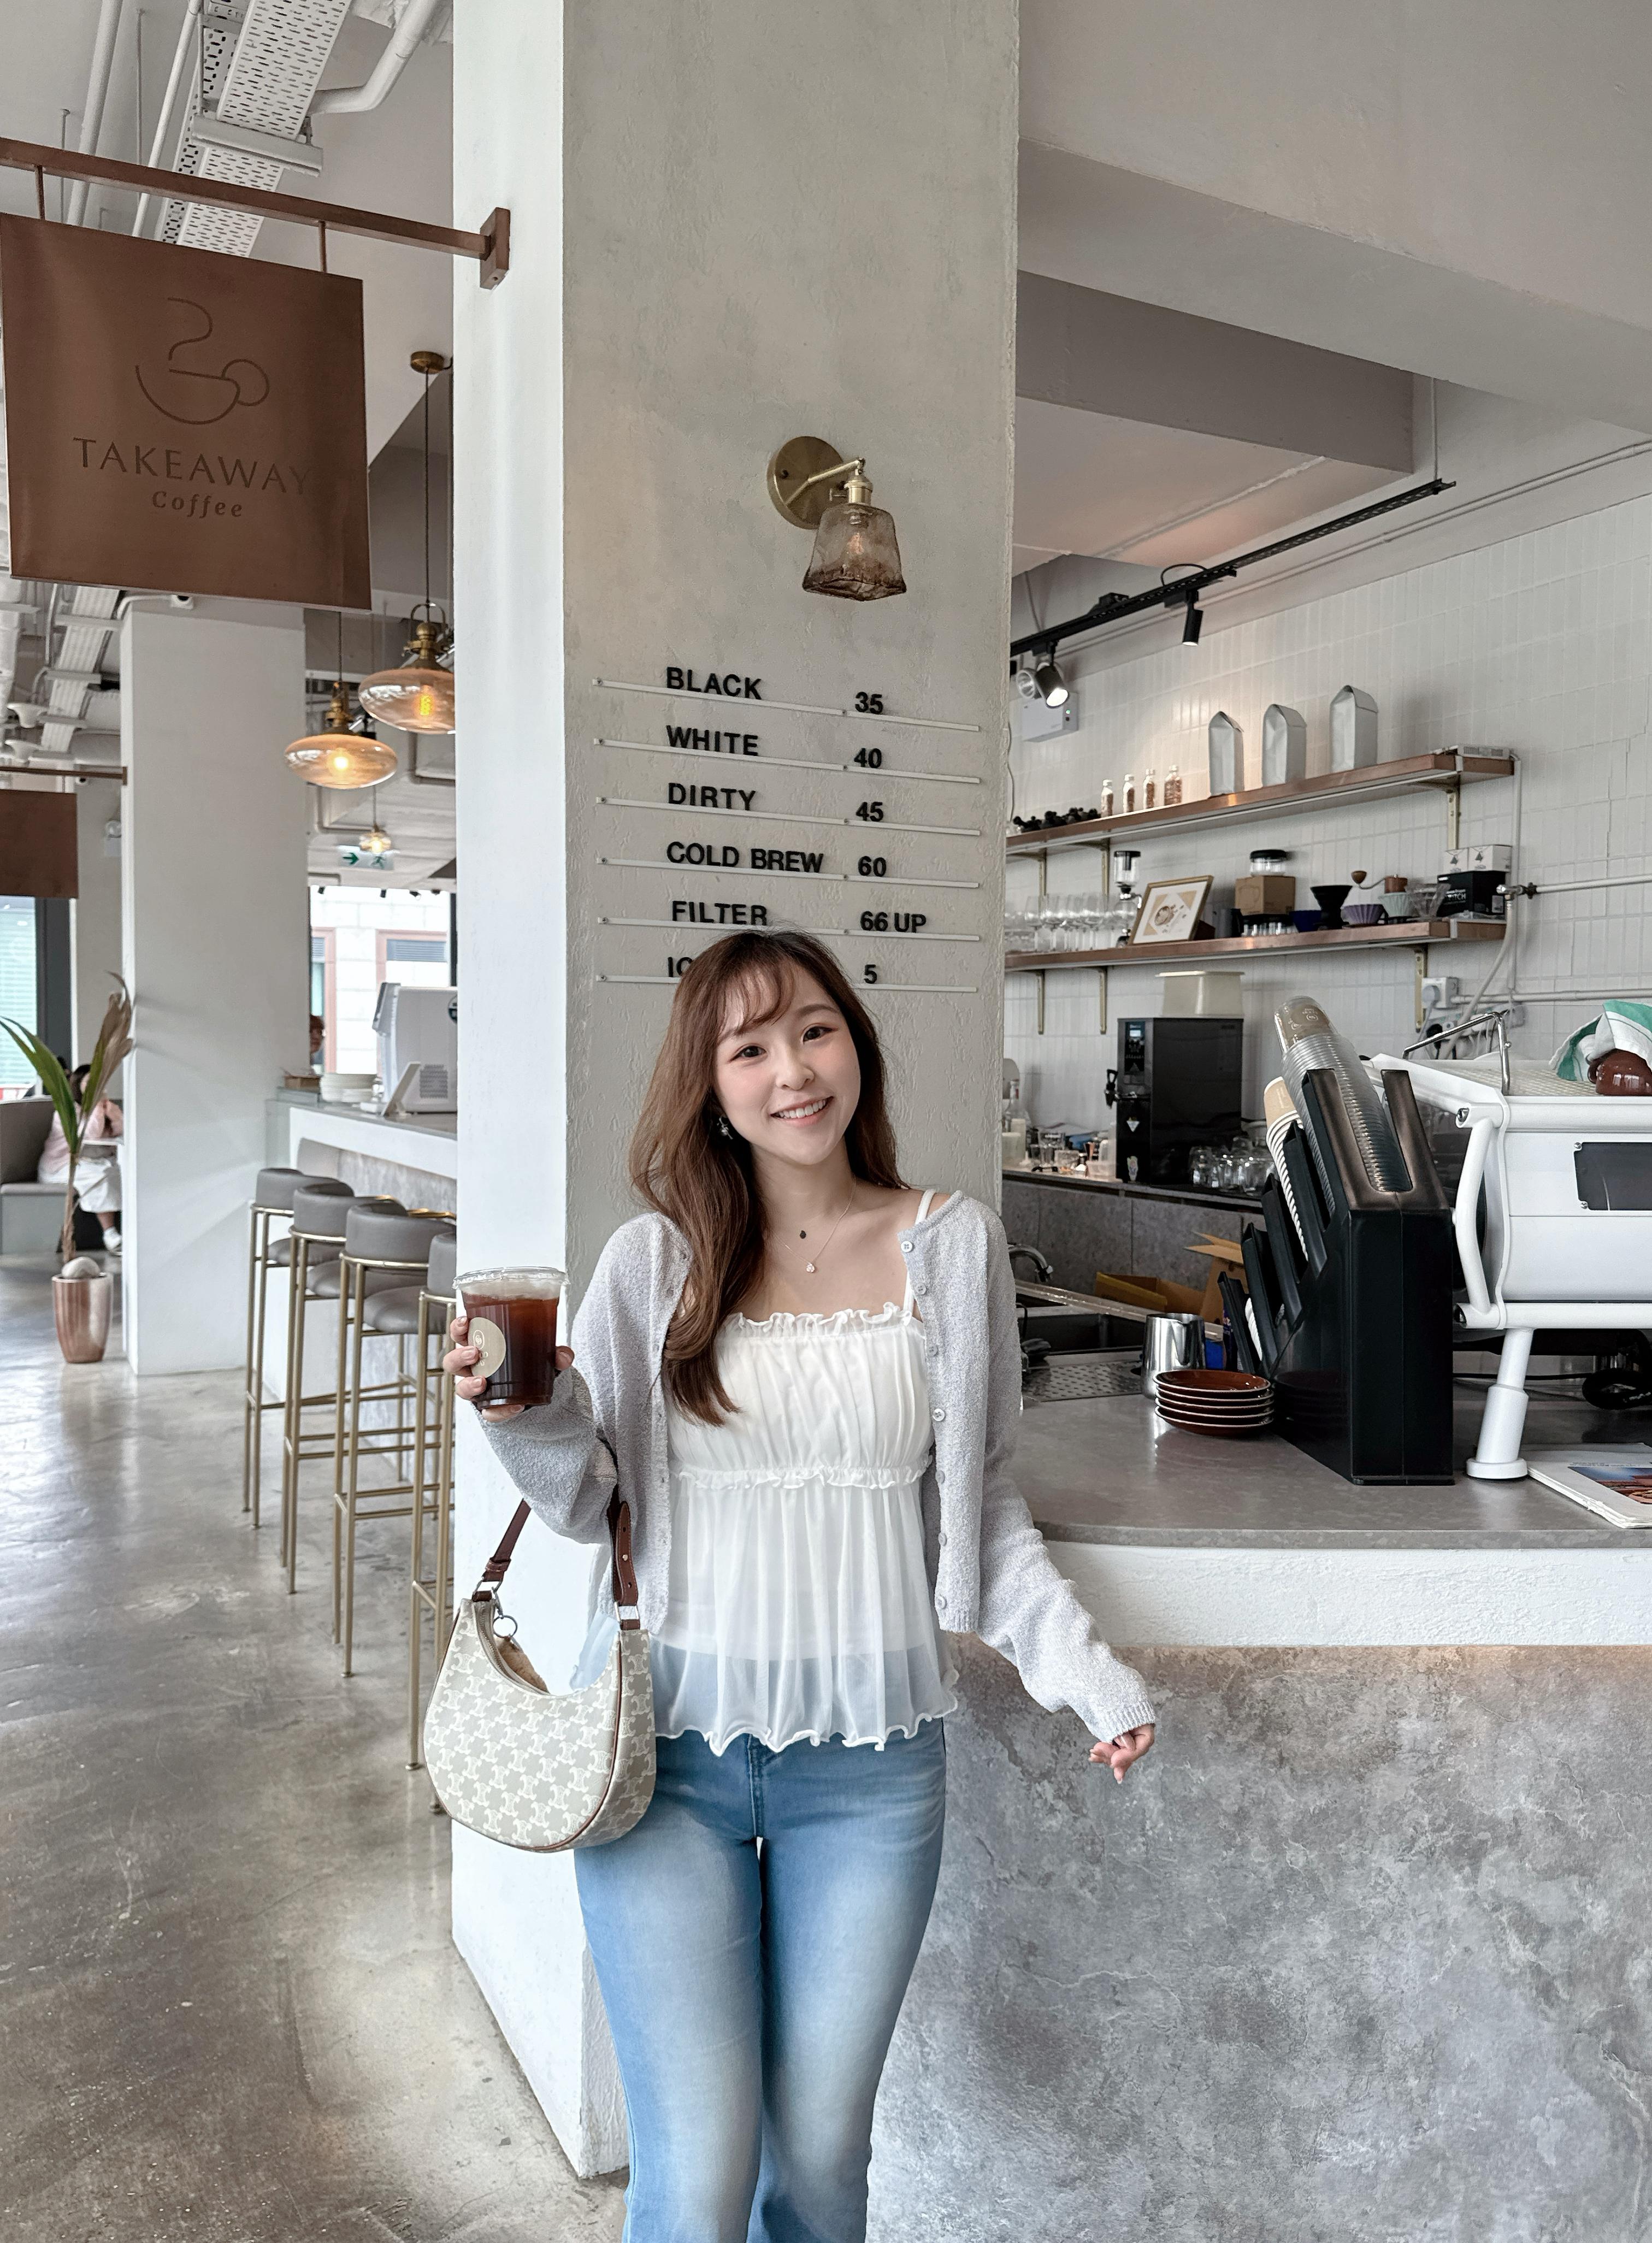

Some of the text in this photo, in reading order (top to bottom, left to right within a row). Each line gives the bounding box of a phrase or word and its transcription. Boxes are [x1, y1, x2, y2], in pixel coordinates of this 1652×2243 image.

[73, 436, 310, 494] TAKEAWAY
[152, 491, 243, 519] Coffee
[666, 666, 884, 715] BLACK 35
[666, 725, 882, 769] WHITE 40
[668, 782, 884, 822] DIRTY 45
[666, 841, 887, 877] COLD BREW 60
[672, 900, 927, 934] FILTER 66 UP
[864, 964, 877, 984] 5
